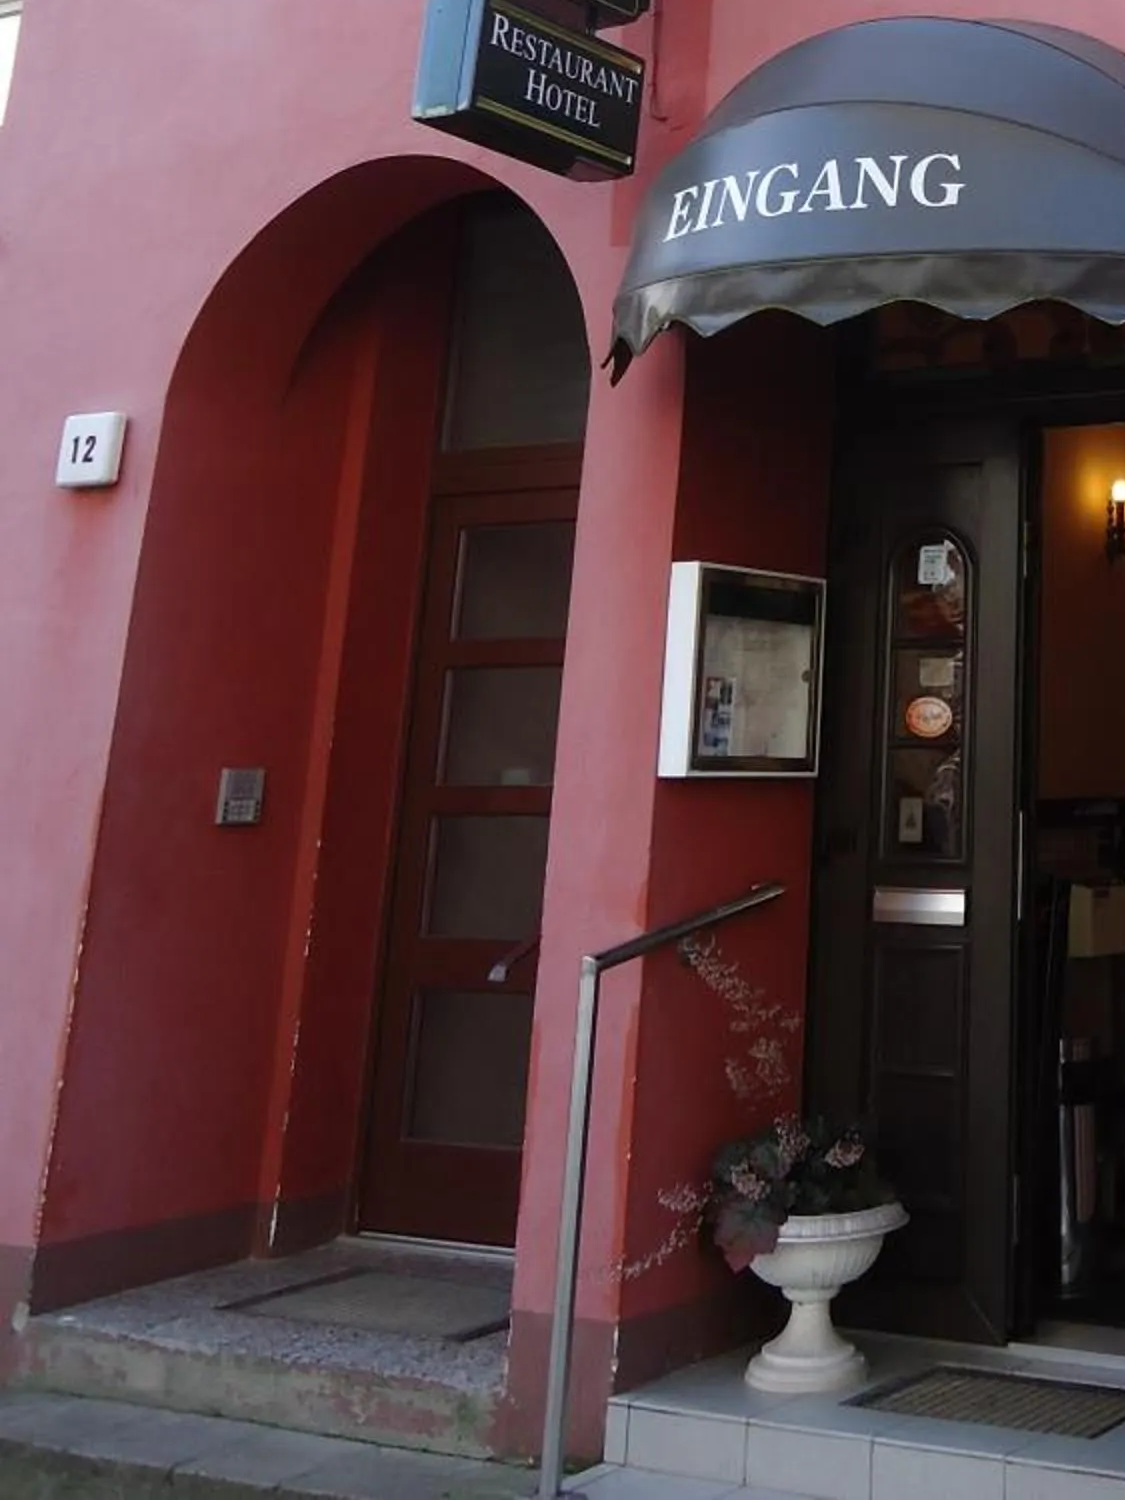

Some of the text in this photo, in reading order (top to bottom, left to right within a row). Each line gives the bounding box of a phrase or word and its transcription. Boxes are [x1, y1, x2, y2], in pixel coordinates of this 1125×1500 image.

[490, 12, 638, 104] RESTAURANT
[525, 67, 600, 128] HOTEL
[662, 152, 966, 242] EINGANG
[71, 435, 97, 464] 12
